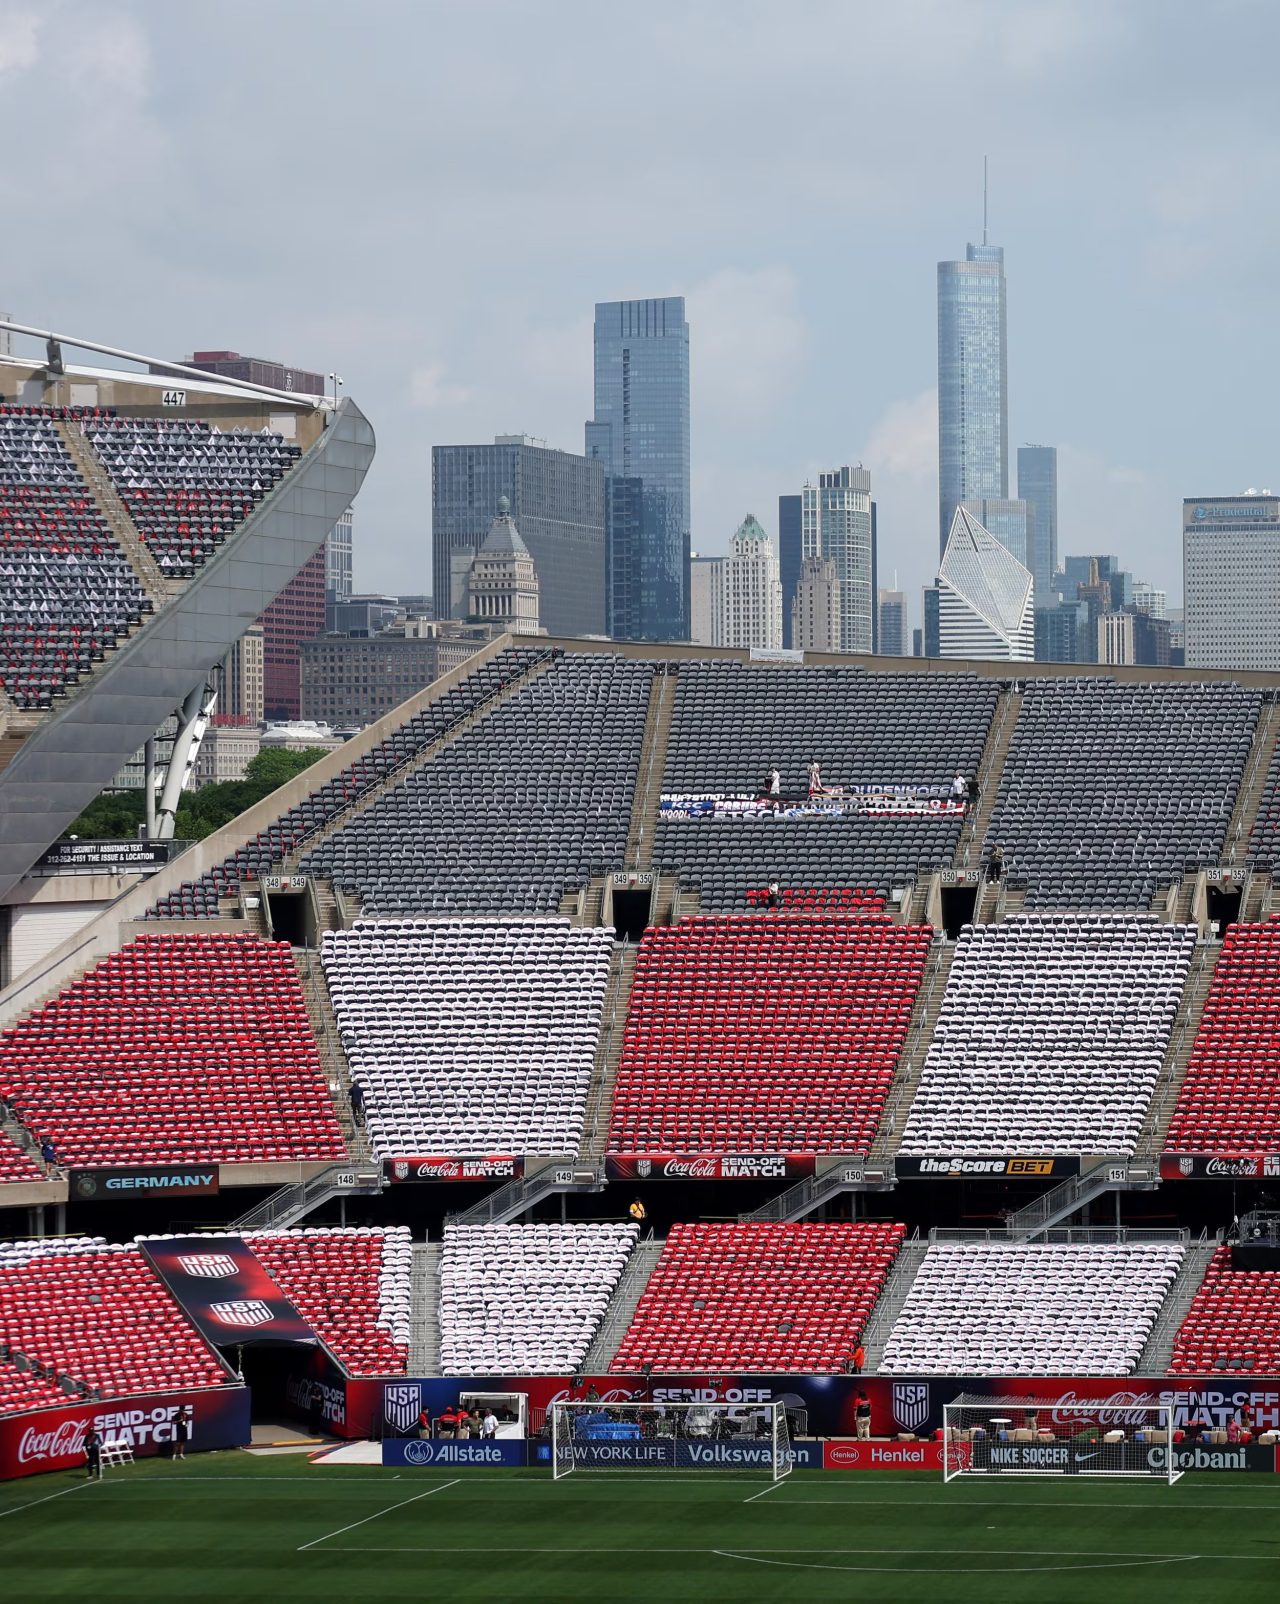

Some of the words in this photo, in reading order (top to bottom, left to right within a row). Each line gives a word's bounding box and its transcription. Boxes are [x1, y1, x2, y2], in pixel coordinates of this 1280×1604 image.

[163, 392, 185, 405] 447
[671, 801, 704, 809] KSC
[60, 846, 71, 854] FOR
[72, 845, 96, 853] SECURITY
[100, 844, 130, 852] ASSISTANCE
[130, 844, 144, 852] TEXT
[88, 854, 100, 862] THE
[100, 854, 118, 862] ISSUE
[126, 852, 154, 860] LOCATION
[614, 874, 627, 884] 349
[640, 874, 651, 884] 350
[942, 872, 955, 882] 350
[967, 871, 979, 881] 351
[1208, 870, 1221, 880] 351
[1233, 870, 1246, 880] 352
[266, 877, 279, 888] 348
[292, 877, 304, 887] 349
[463, 1160, 514, 1168] SEND-OFF
[664, 1158, 720, 1177] Coca-Cola
[721, 1158, 785, 1166] SEND-OFF
[920, 1158, 1006, 1172] theScore
[1010, 1162, 1050, 1172] BET
[417, 1162, 461, 1178] Coca-Cola
[463, 1168, 514, 1176] MATCH
[721, 1166, 785, 1176] MATCH
[846, 1171, 861, 1180] 150
[1110, 1170, 1124, 1180] 151
[106, 1174, 214, 1189] GERMANY
[338, 1174, 354, 1185] 148
[557, 1172, 571, 1181] 149
[183, 1256, 228, 1265] USA
[216, 1302, 262, 1312] USA
[388, 1386, 418, 1405] USA
[652, 1388, 771, 1402] SEND-OFF
[896, 1386, 926, 1402] USA
[1159, 1392, 1278, 1406] SEND-OFF
[1052, 1391, 1154, 1424] Coca-Cola
[1159, 1408, 1278, 1427] MATCH
[94, 1420, 192, 1447] MATCH
[18, 1418, 90, 1463] Coca-Cola
[435, 1445, 502, 1462] Allstate
[555, 1447, 592, 1459] NEW
[592, 1447, 633, 1459] YORK
[635, 1447, 665, 1459] LIFE
[688, 1444, 808, 1468] Volkswagen
[871, 1448, 924, 1462] Henkel
[991, 1448, 1020, 1463] NIKE
[1023, 1448, 1068, 1463] SOCCER
[1148, 1447, 1246, 1469] Chobani
